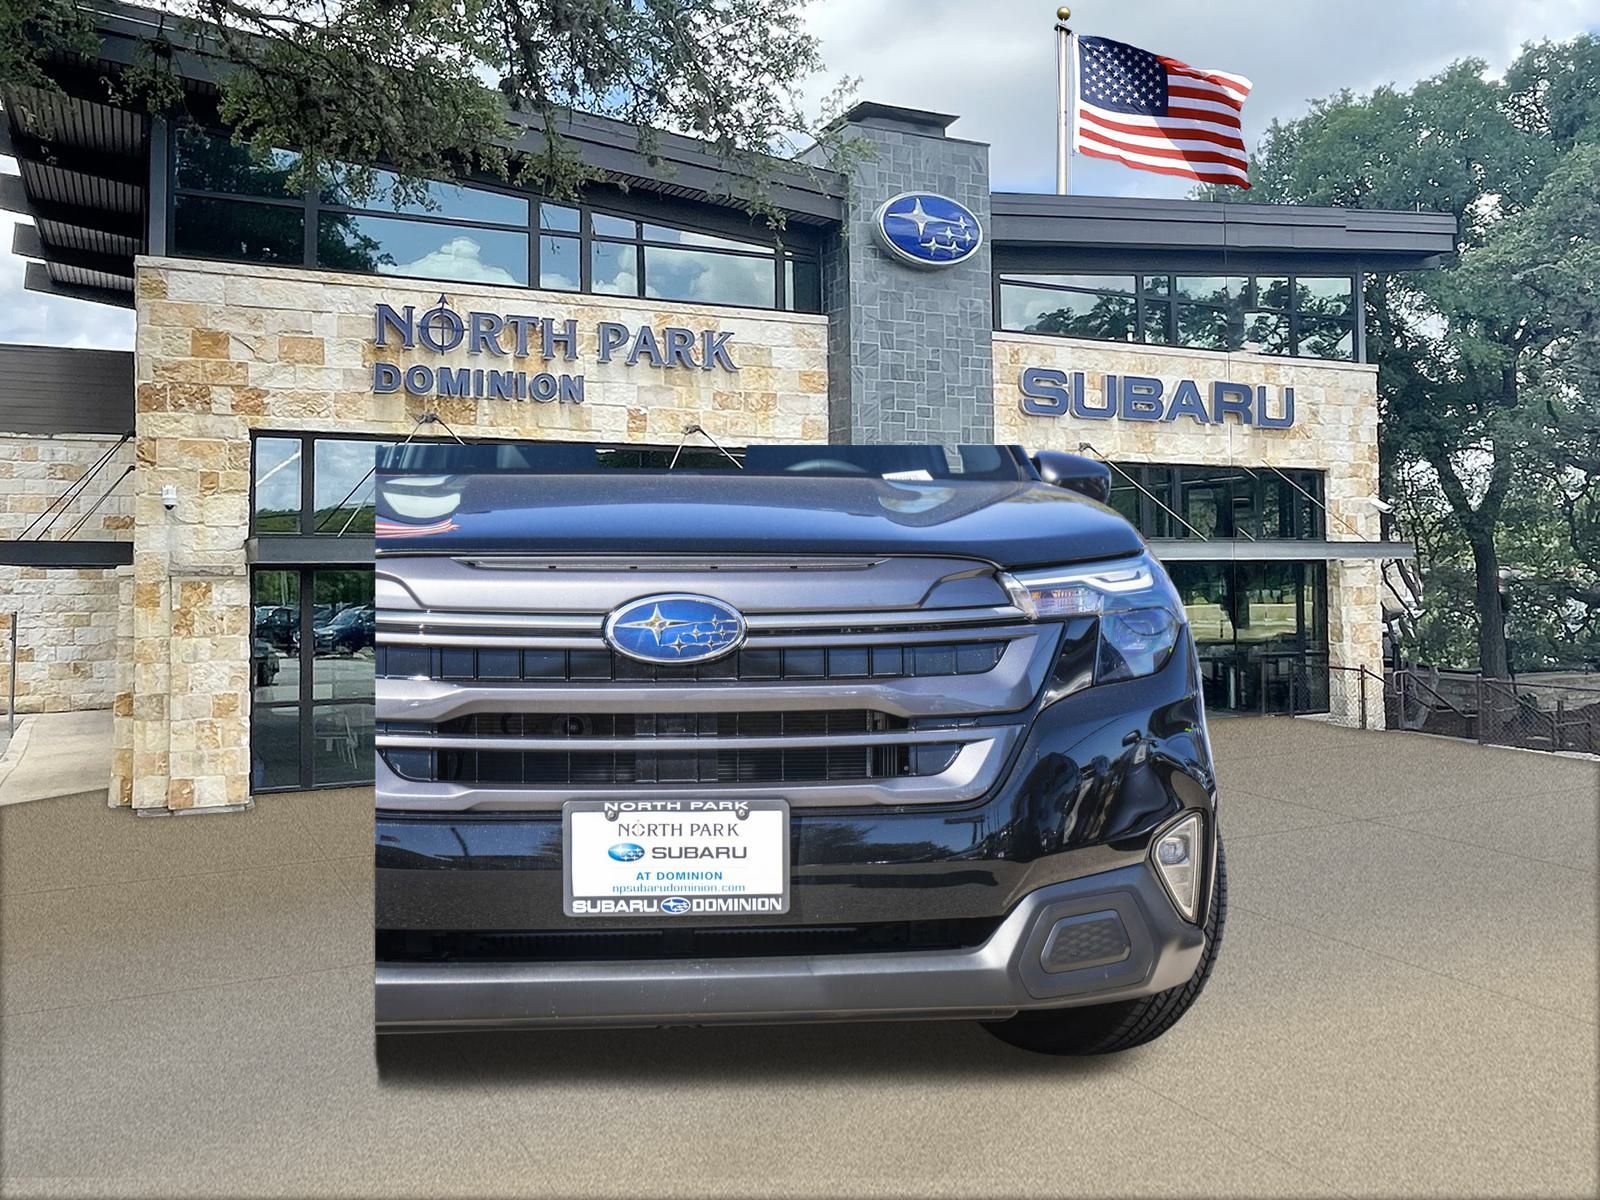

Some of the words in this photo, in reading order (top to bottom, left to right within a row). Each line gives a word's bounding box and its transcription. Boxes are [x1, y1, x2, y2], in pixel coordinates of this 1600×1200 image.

[375, 298, 578, 361] NORTH
[596, 321, 741, 373] PARK
[373, 362, 586, 405] DOMINION
[1018, 367, 1294, 430] SUBARU
[604, 801, 681, 812] NORTH
[690, 801, 750, 811] PARK
[618, 821, 682, 837] NORTH
[690, 823, 739, 837] PARK
[652, 846, 747, 859] SUBARU
[636, 872, 651, 881] AT
[656, 871, 723, 881] DOMINION
[612, 883, 746, 894] npsubarudominion.com
[692, 898, 782, 911] DOMINION
